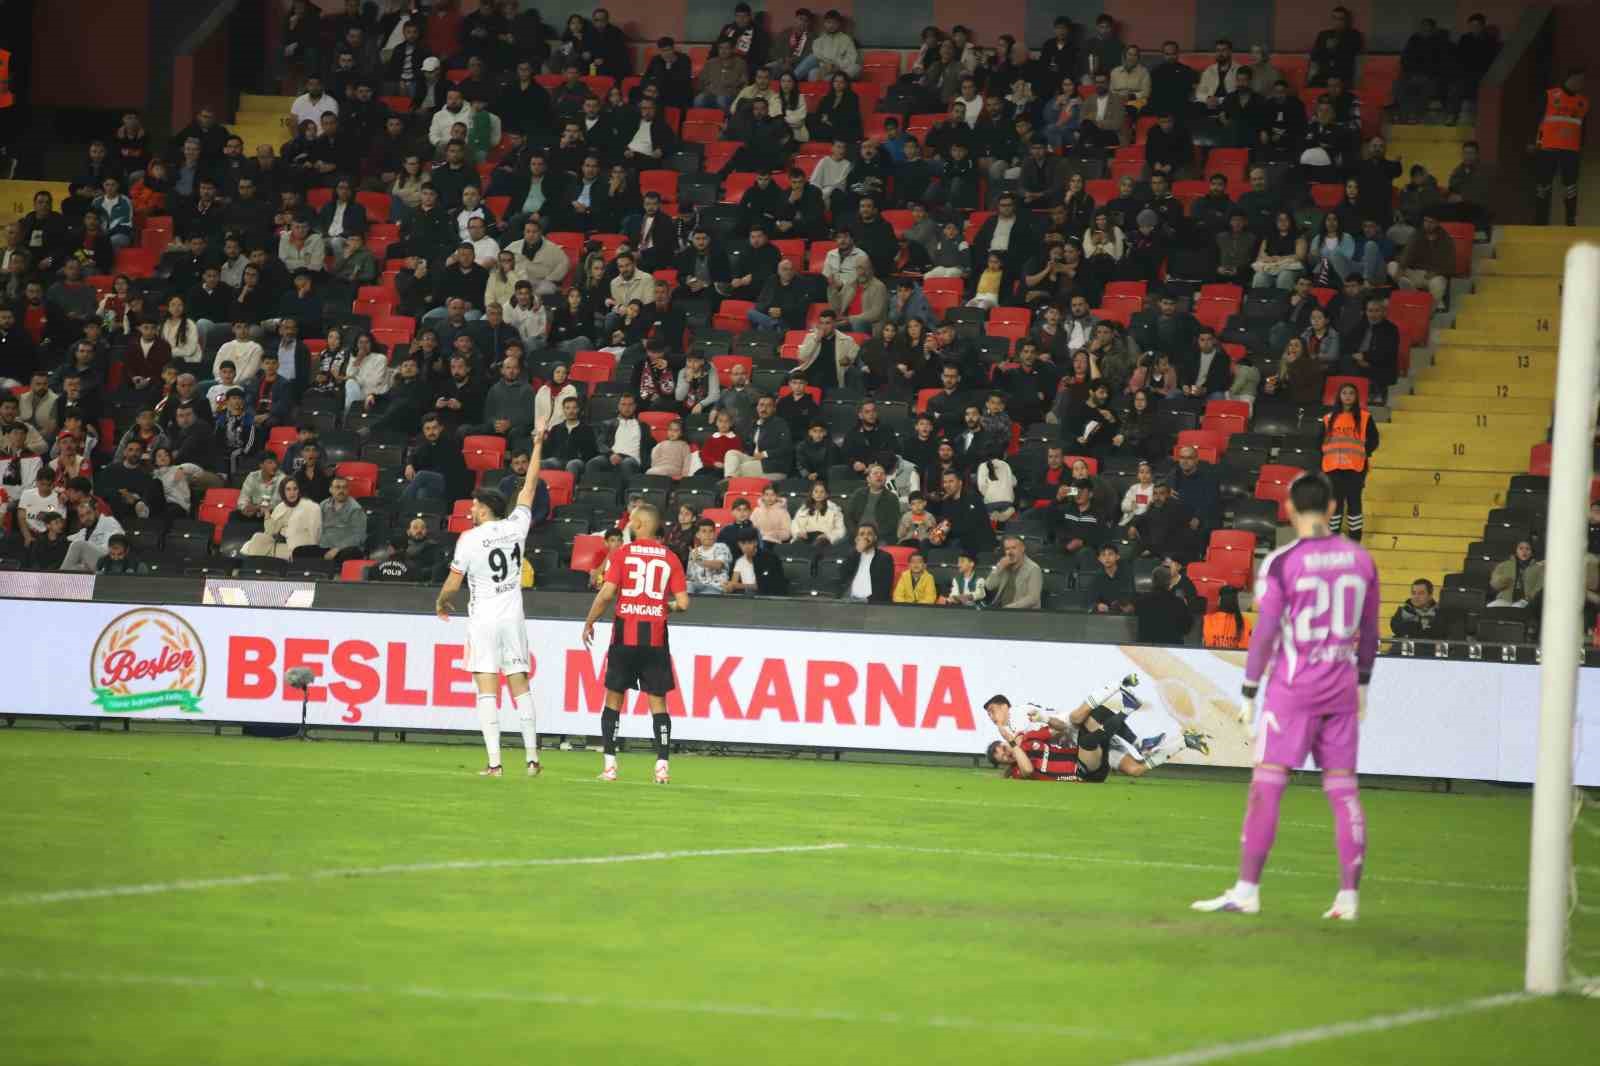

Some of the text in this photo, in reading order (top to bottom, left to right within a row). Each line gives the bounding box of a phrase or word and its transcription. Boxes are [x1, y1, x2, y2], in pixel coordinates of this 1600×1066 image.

[1536, 318, 1549, 331] 14
[1518, 355, 1530, 369] 13
[1496, 385, 1509, 398] 12
[1476, 414, 1488, 428] 11
[1453, 443, 1465, 456] 10
[1433, 473, 1441, 486] 9
[1391, 536, 1398, 549] 7
[488, 542, 521, 583] 91
[621, 556, 672, 600] 30
[620, 603, 664, 617] SANGARÉ
[1295, 572, 1368, 643] 20
